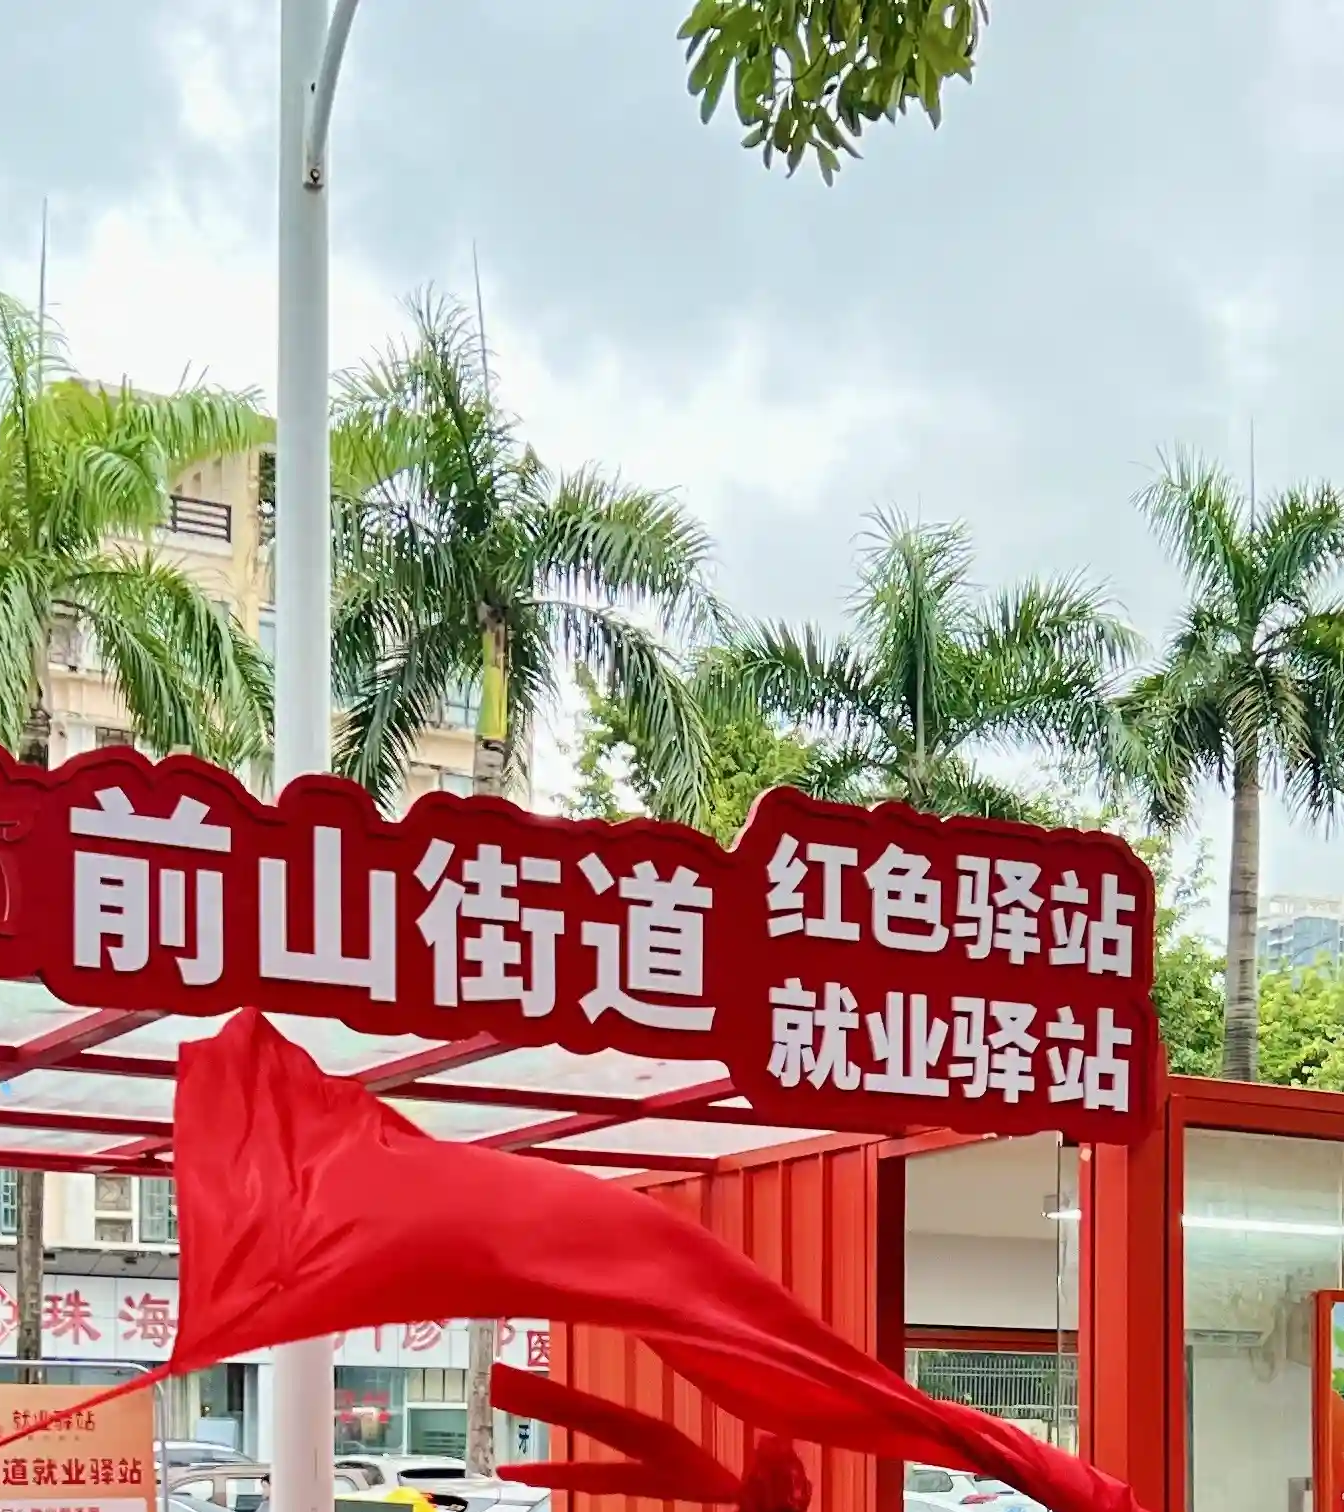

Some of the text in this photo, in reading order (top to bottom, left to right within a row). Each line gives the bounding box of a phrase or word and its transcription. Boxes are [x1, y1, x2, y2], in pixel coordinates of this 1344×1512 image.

[69, 786, 717, 1031] 前山街道
[765, 832, 1137, 979] 红色驿站
[766, 976, 1133, 1114] 就业驿站
